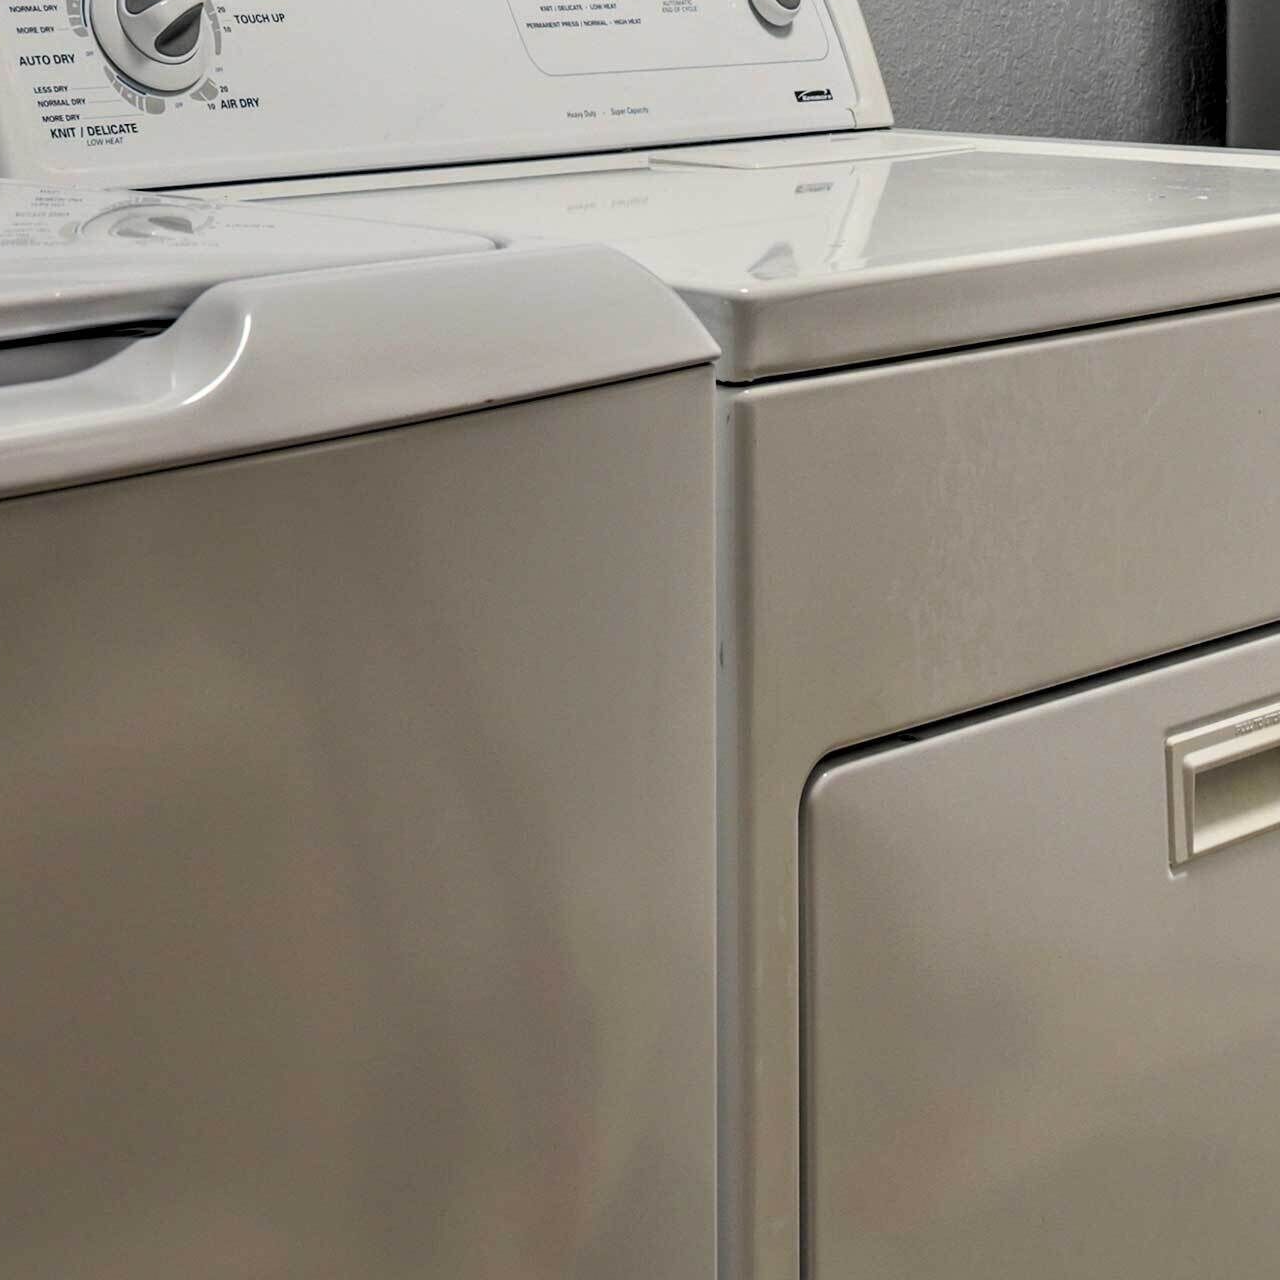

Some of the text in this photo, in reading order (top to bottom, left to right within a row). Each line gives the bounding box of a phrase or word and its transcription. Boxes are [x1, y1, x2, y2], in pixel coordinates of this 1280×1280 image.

[9, 5, 42, 13] NORMAL
[217, 6, 226, 14] 20
[233, 13, 286, 25] TOUCH UP
[16, 26, 55, 35] MORE DRY
[19, 53, 76, 67] AUTO DRY
[33, 85, 69, 94] LESS DRY
[38, 98, 86, 108] NORMAL DRY
[221, 97, 260, 109] AIR DRY
[42, 114, 80, 123] MORE DRY
[50, 127, 77, 139] KNIT
[86, 123, 139, 136] DELICATE
[86, 137, 124, 147] LOW HEAT
